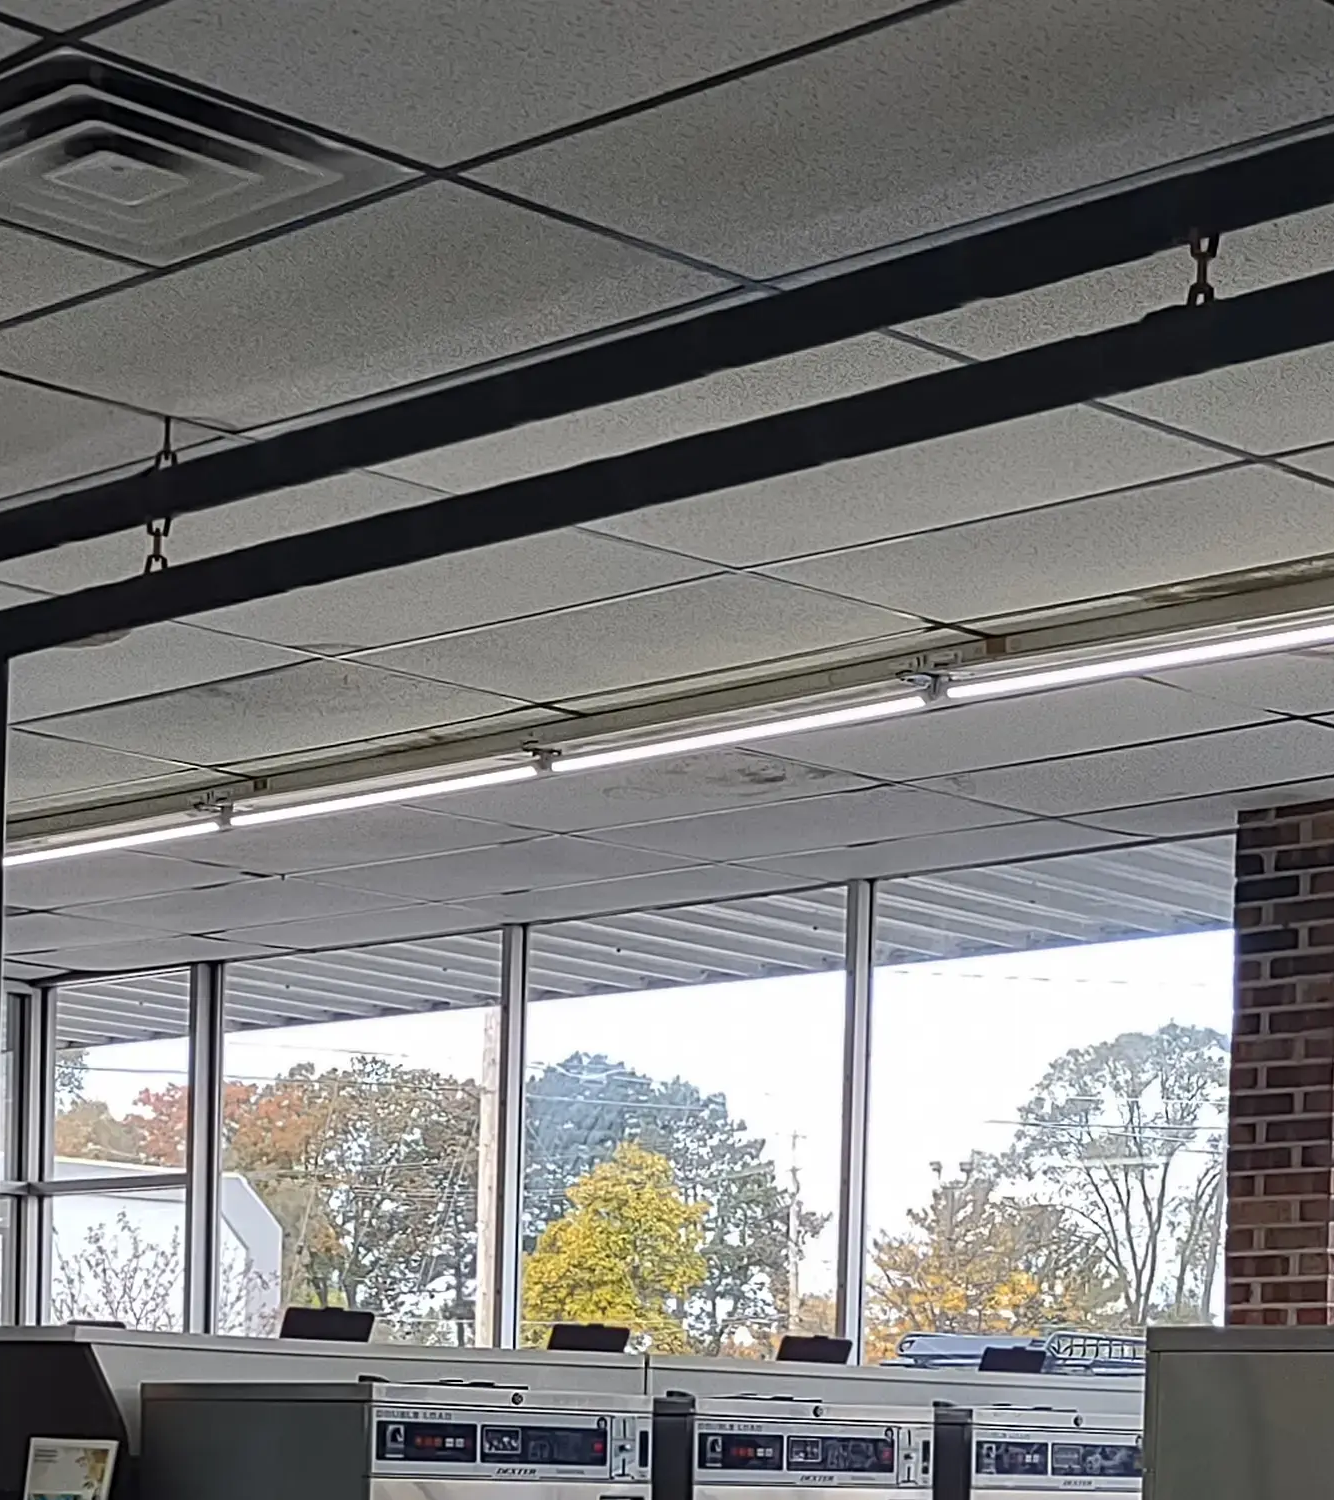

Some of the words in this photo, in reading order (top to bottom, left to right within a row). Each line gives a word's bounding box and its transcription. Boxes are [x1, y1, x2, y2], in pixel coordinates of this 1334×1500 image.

[376, 1409, 419, 1419] DOUBLE
[423, 1411, 452, 1420] LOAD
[496, 1467, 537, 1475] DEXTER
